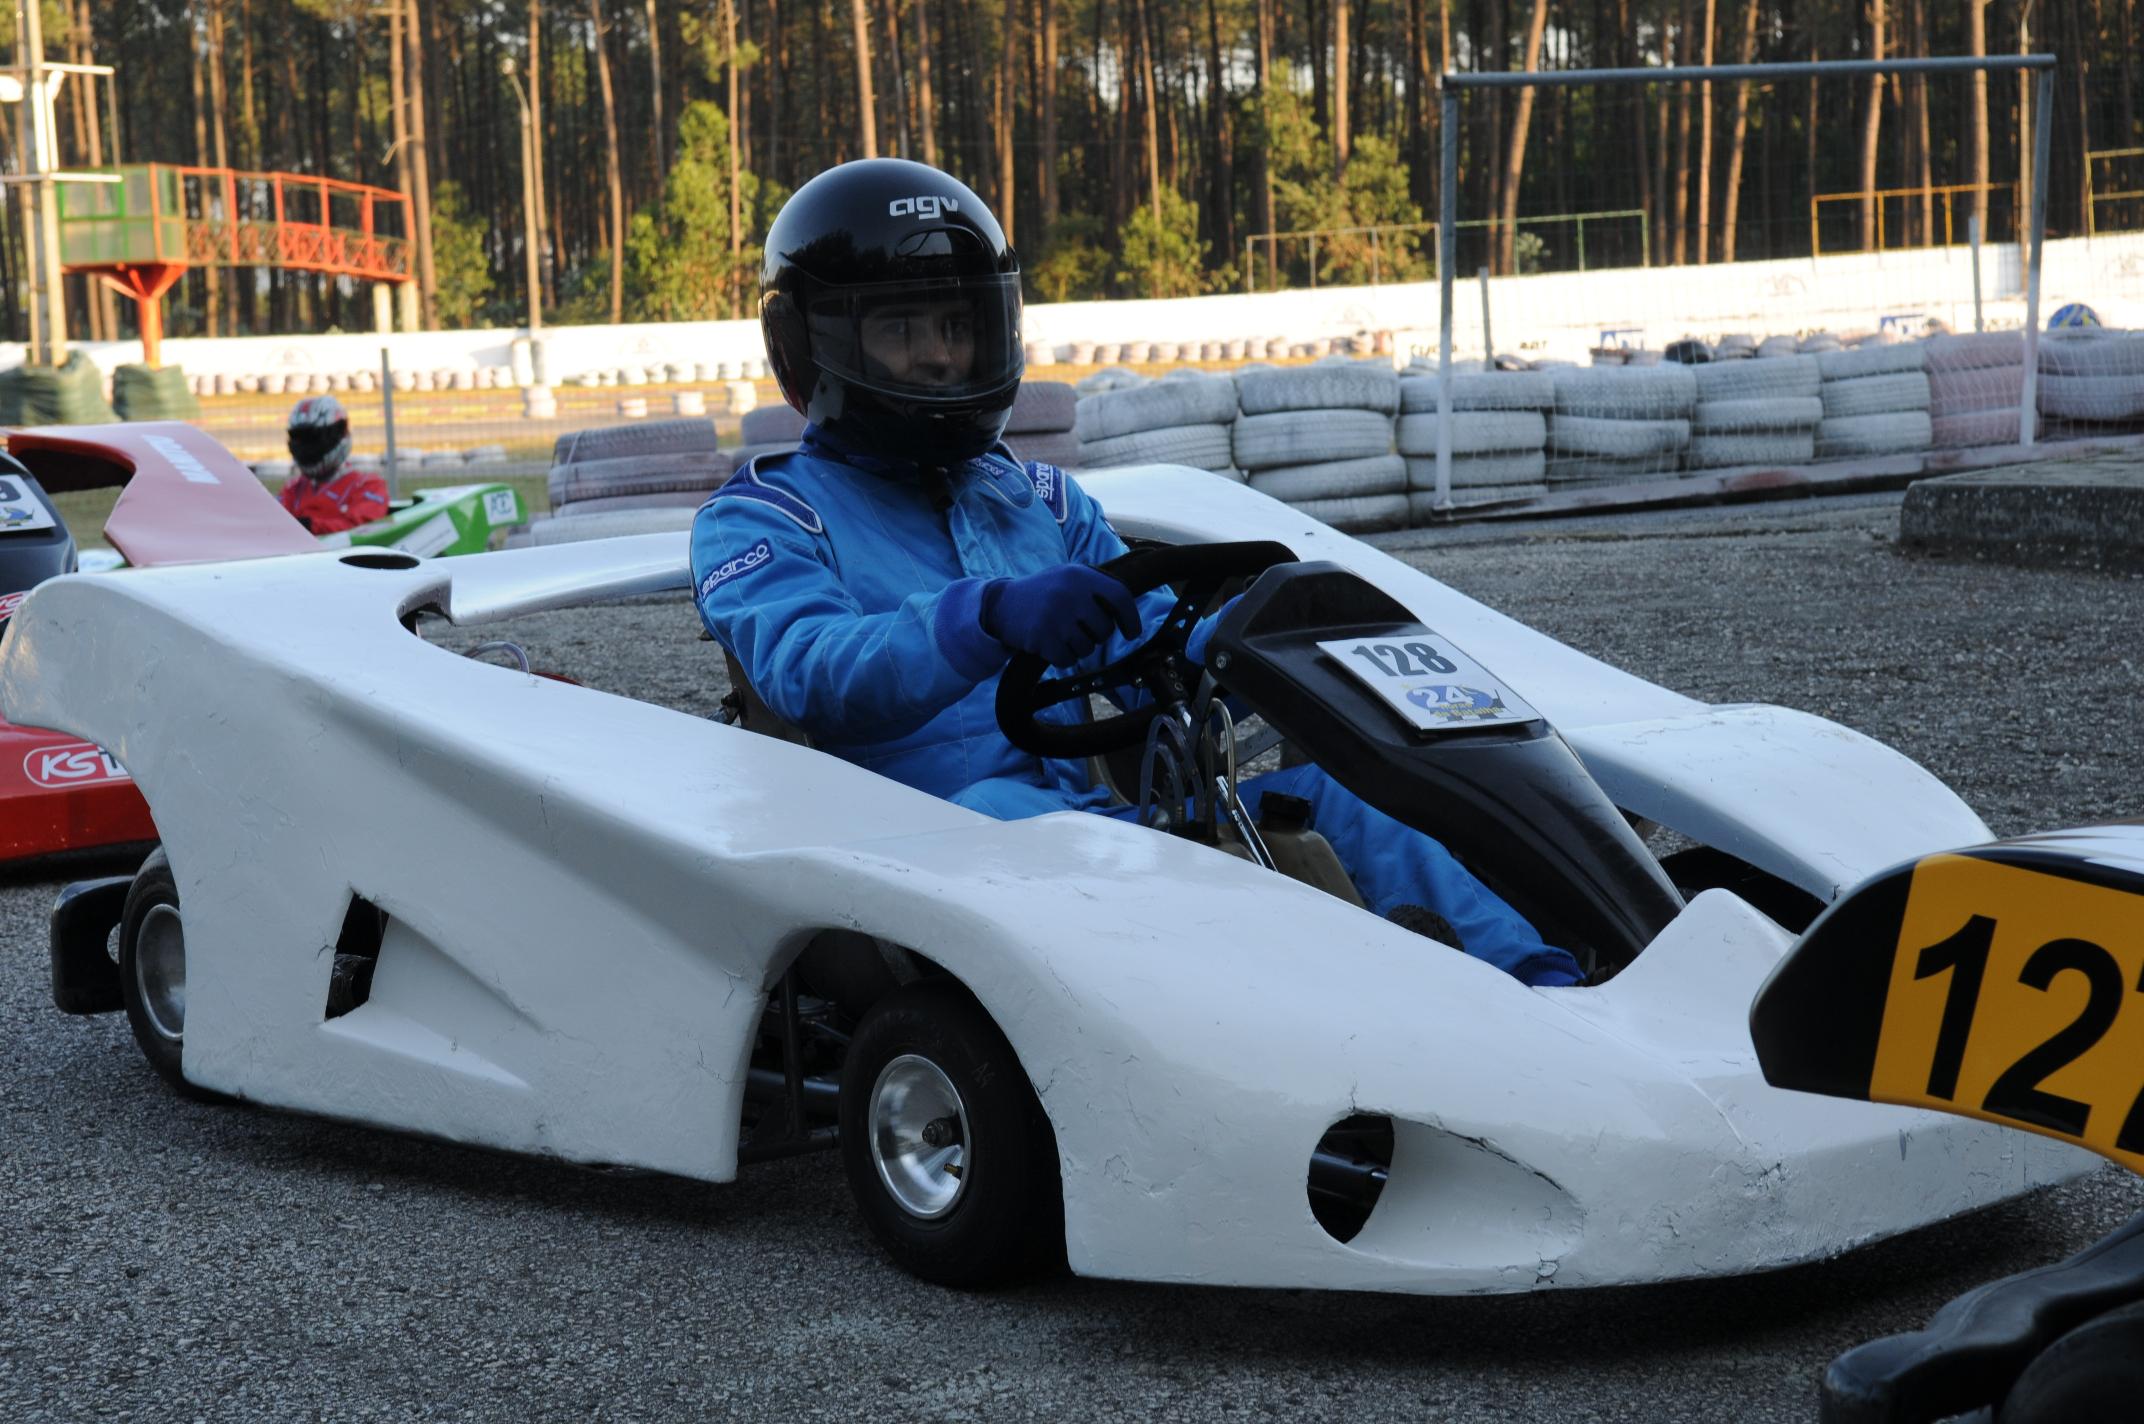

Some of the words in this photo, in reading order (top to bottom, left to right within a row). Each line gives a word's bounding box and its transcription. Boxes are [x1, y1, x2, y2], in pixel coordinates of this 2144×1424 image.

[889, 196, 959, 220] agv
[1351, 642, 1458, 677] 128
[1412, 685, 1474, 708] 24
[1914, 914, 2144, 1155] 12
